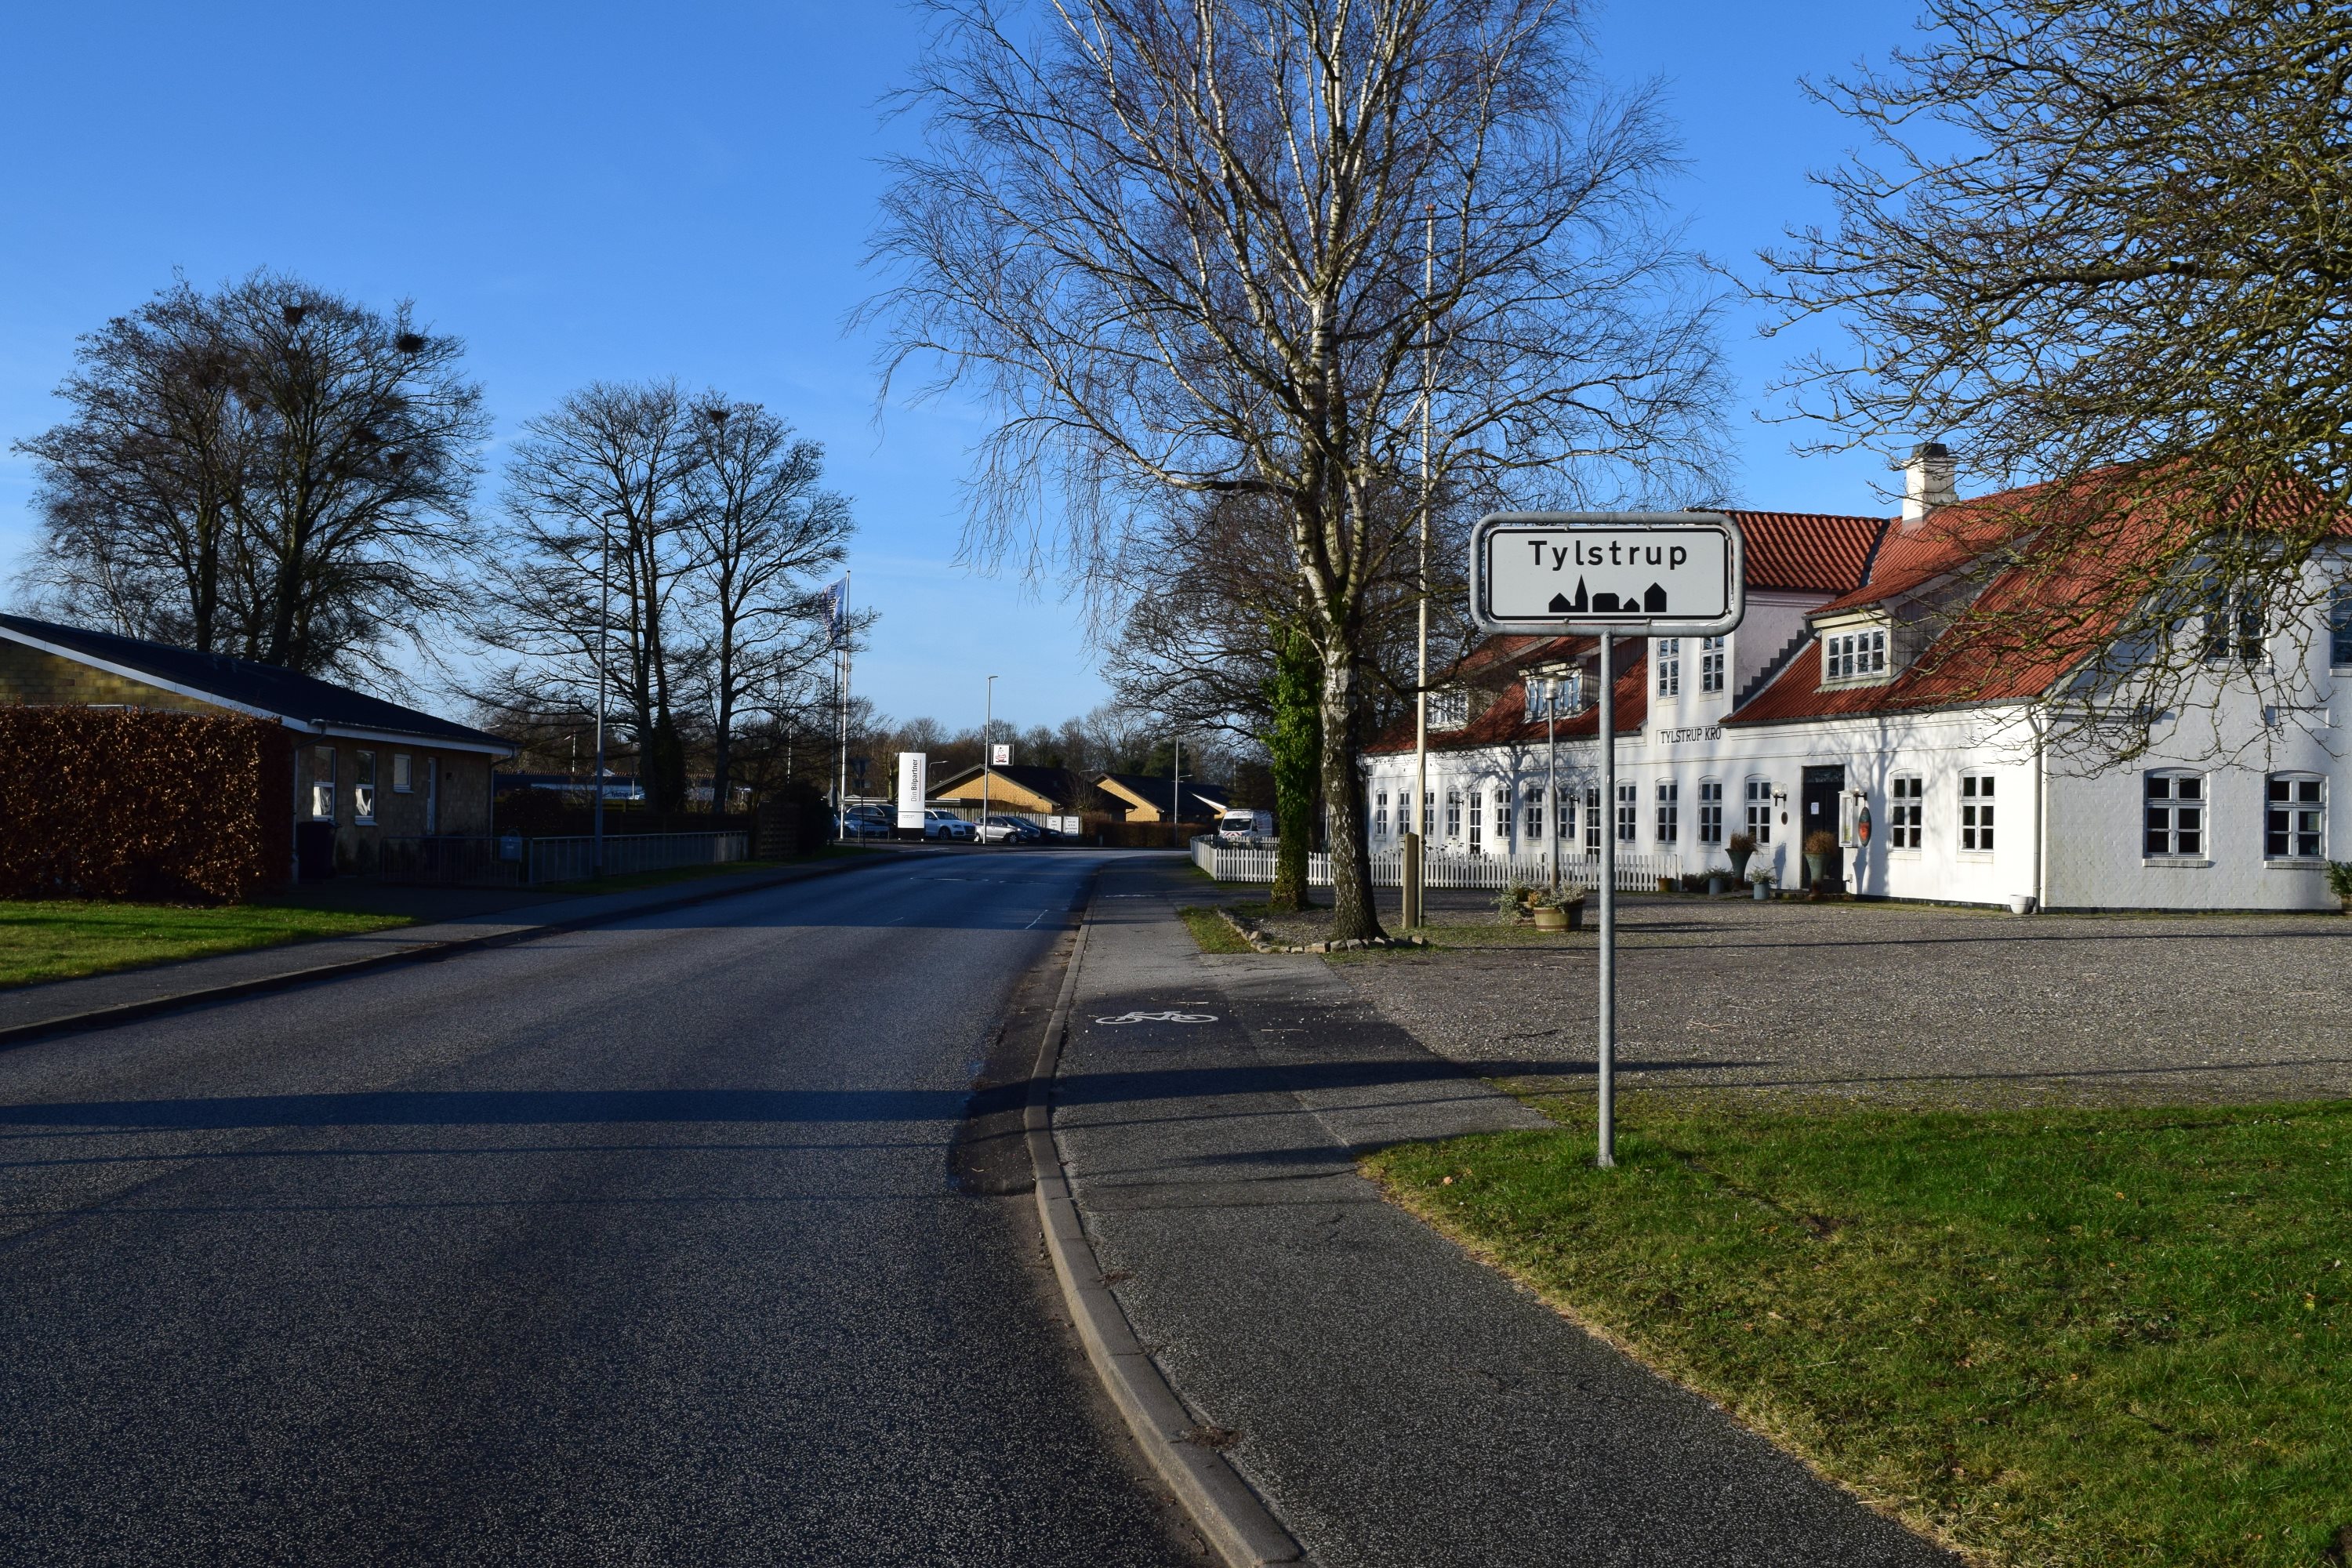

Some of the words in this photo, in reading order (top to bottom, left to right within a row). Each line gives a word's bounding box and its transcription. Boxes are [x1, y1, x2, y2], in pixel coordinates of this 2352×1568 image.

[1528, 540, 1687, 572] Tylstrup
[1661, 728, 1702, 743] TYLSTRUP
[1704, 727, 1722, 741] KRO
